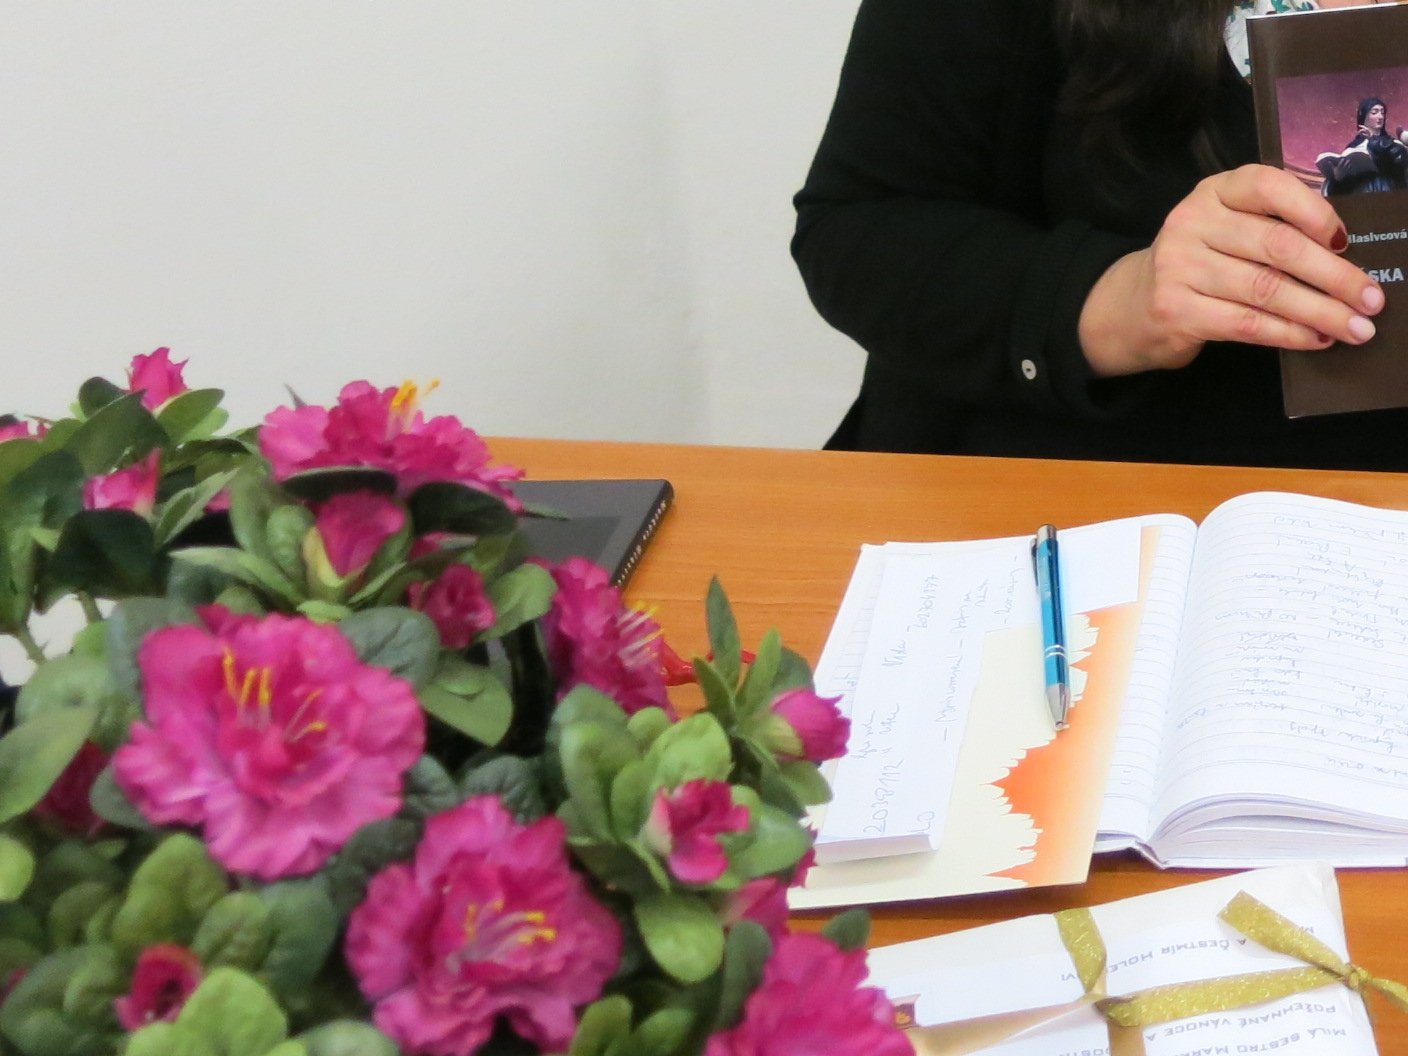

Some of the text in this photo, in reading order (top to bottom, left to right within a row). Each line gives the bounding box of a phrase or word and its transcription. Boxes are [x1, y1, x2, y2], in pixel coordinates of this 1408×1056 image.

[1160, 939, 1230, 955] ČESTMÍR
[1238, 1002, 1337, 1028] POŽEHNANÉ
[1145, 1031, 1157, 1042] A
[1306, 1027, 1347, 1039] MILÁ
